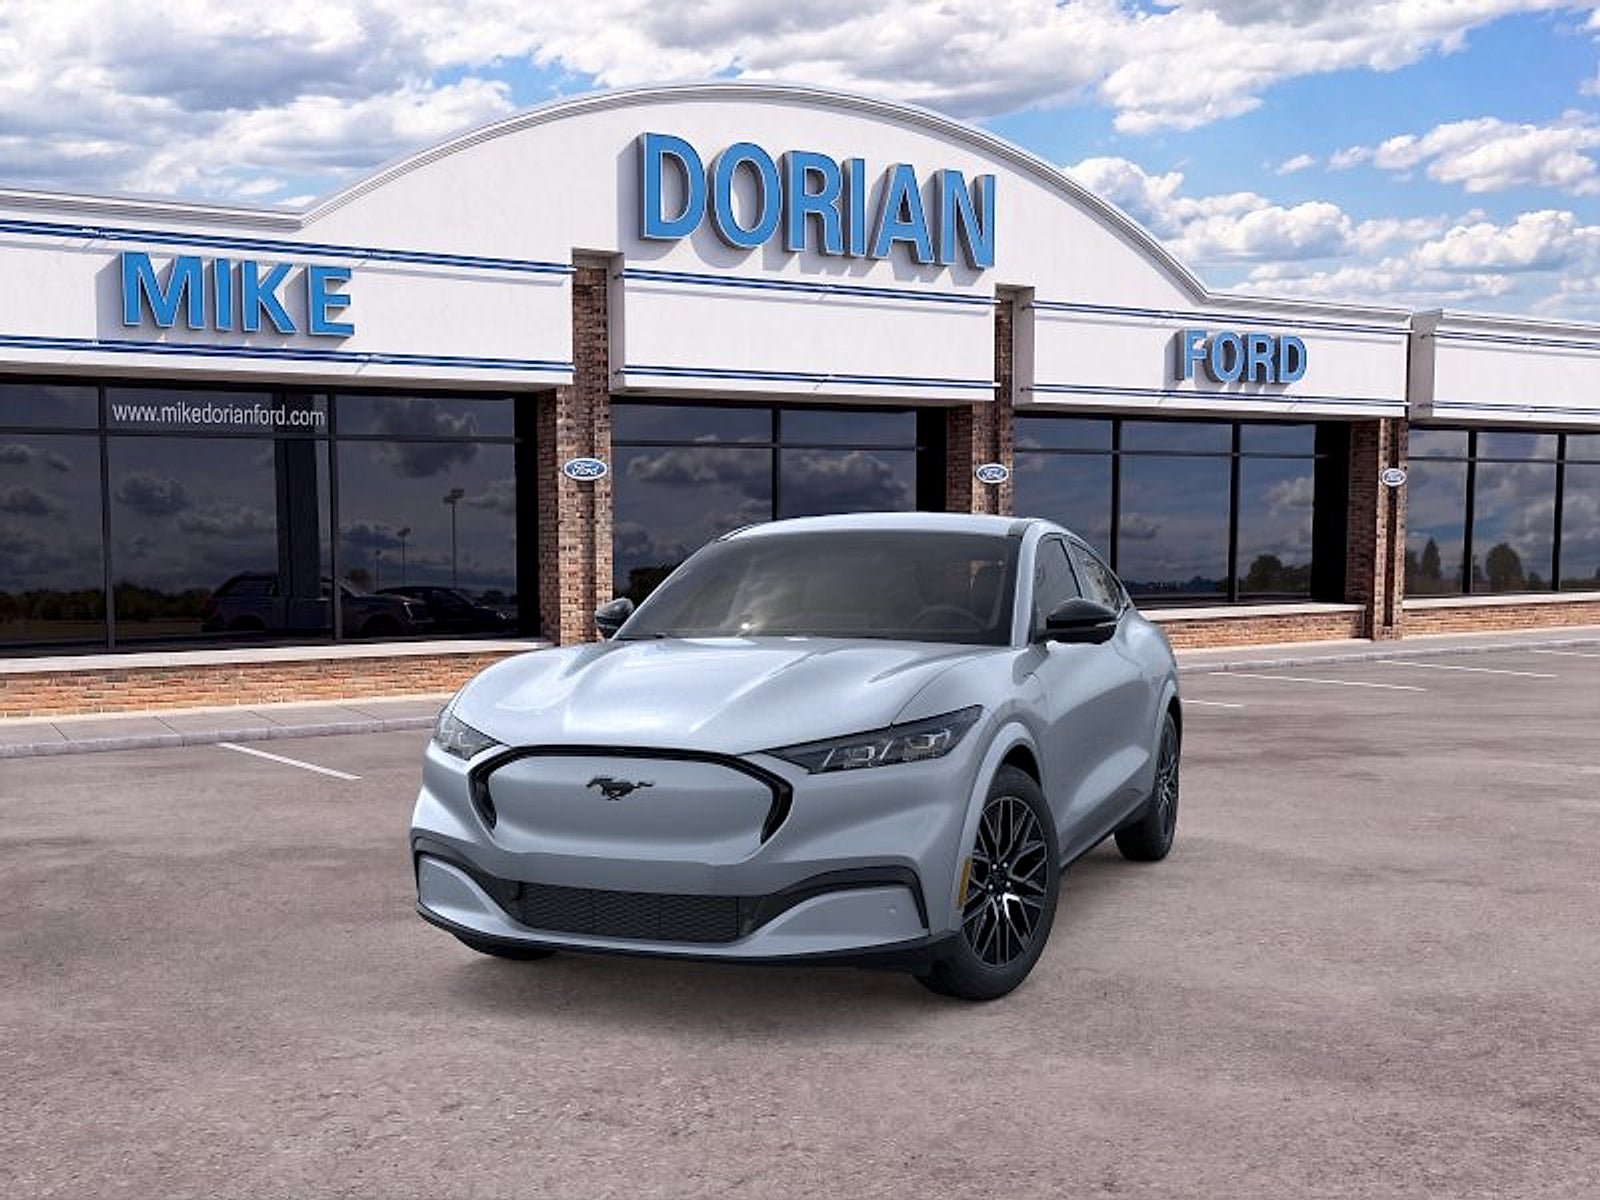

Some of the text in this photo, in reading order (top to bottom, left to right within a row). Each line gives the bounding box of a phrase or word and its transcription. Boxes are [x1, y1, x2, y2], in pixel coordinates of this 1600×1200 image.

[641, 132, 995, 269] DORIAN
[122, 251, 355, 336] MIKE
[1179, 328, 1307, 383] FORD
[111, 402, 325, 426] www.mikedorianford.com
